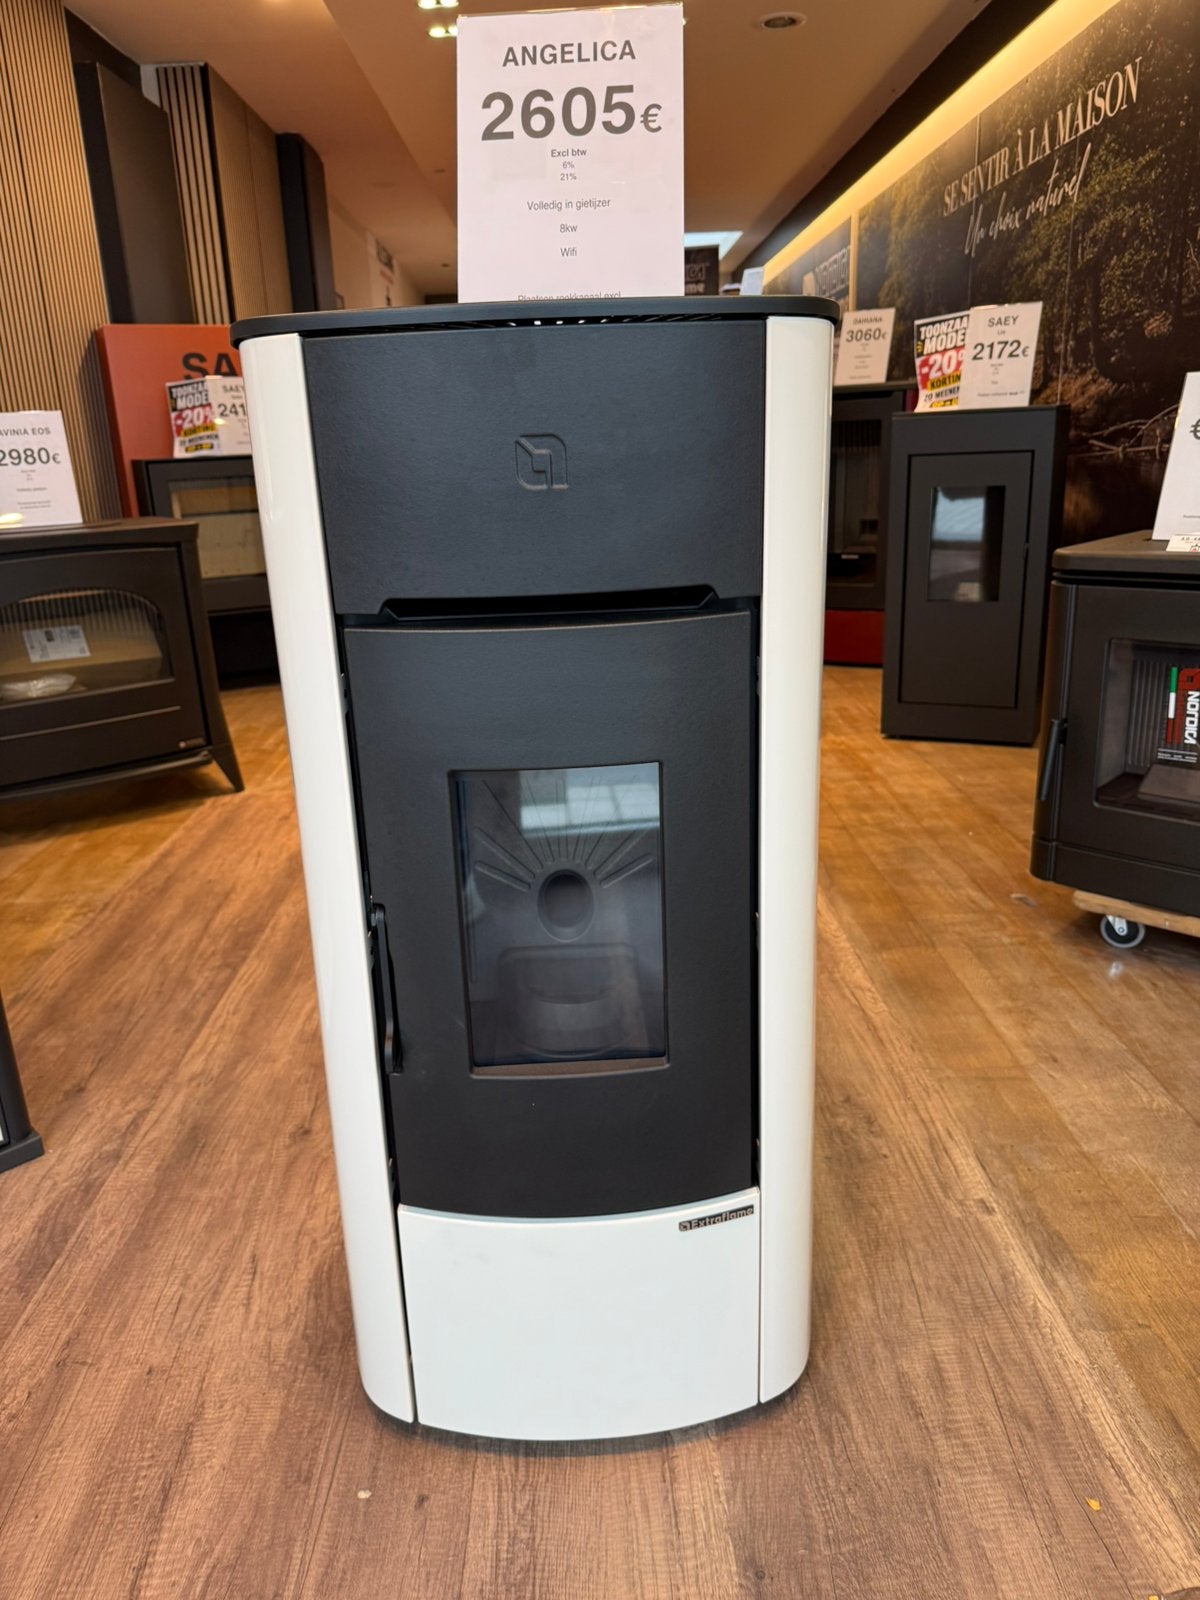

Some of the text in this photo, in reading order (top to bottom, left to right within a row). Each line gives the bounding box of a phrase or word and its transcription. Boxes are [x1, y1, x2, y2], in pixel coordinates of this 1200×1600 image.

[502, 39, 636, 67] ANGELICA
[481, 84, 663, 141] 2605€
[943, 56, 1143, 217] SE SENTIR À LA MAISON
[550, 148, 588, 158] Excl btw
[562, 160, 575, 169] 6%
[560, 172, 577, 181] 21%
[988, 191, 1022, 240] choix
[1026, 142, 1092, 219] naturel
[527, 197, 611, 212] Volledig in gietijzer
[559, 223, 578, 234] 8kw
[560, 247, 578, 257] Wifi
[987, 315, 1019, 328] SAEY
[971, 339, 1030, 361] 2172€
[32, 427, 51, 436] EOS
[691, 1207, 753, 1229] Extraflame
